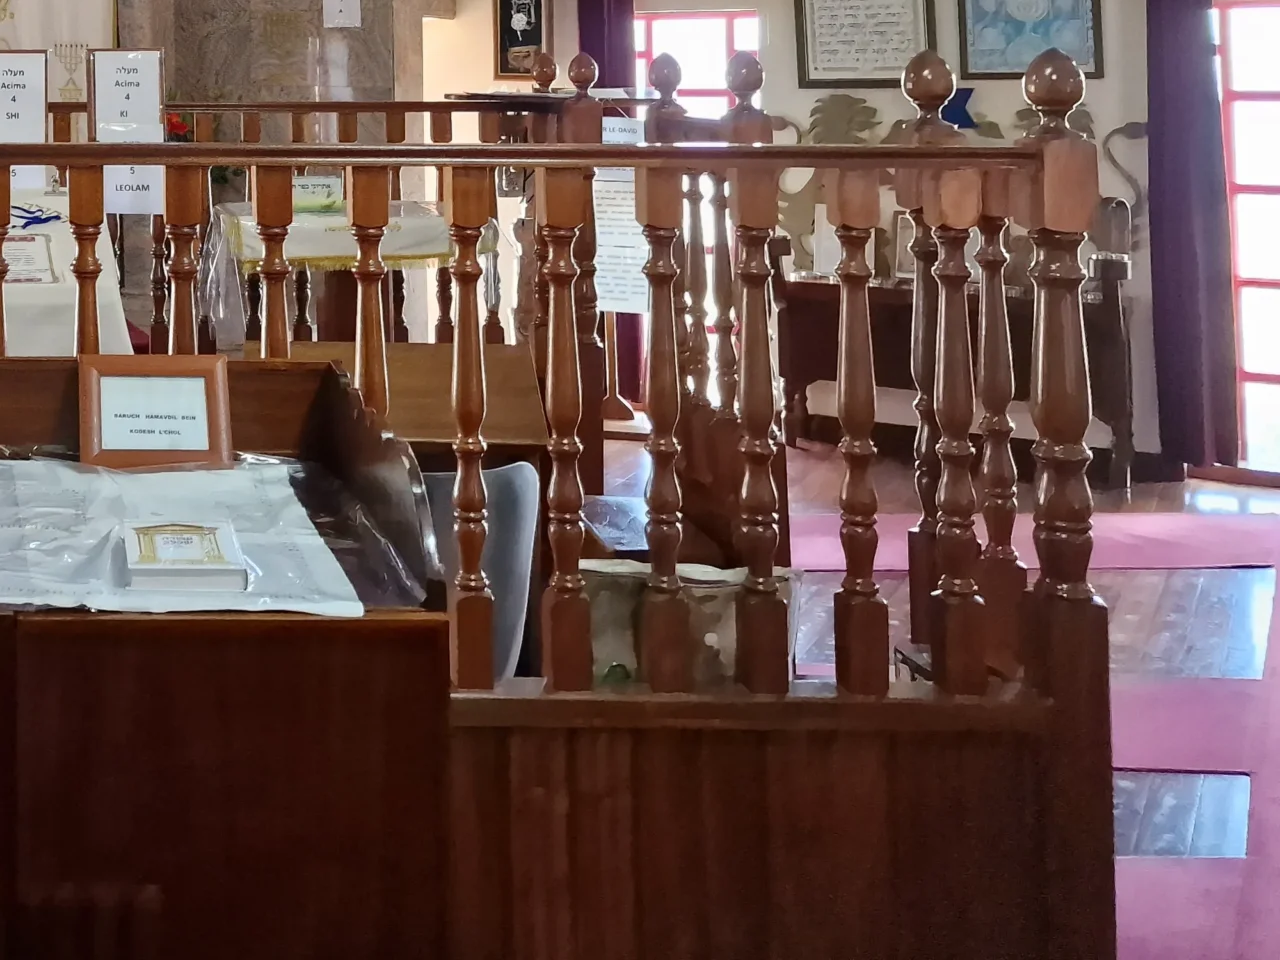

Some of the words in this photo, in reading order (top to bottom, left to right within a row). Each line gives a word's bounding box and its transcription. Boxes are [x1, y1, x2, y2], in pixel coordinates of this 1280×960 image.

[2, 69, 25, 77] מעלה
[115, 66, 138, 75] מעלה
[0, 82, 26, 90] Acima
[114, 80, 140, 88] Acima
[11, 95, 16, 103] 4
[124, 93, 130, 101] 4
[5, 112, 20, 120] SHI
[120, 110, 128, 118] KI
[11, 169, 17, 178] 5
[129, 167, 135, 175] 5
[115, 184, 150, 192] LEOLAM
